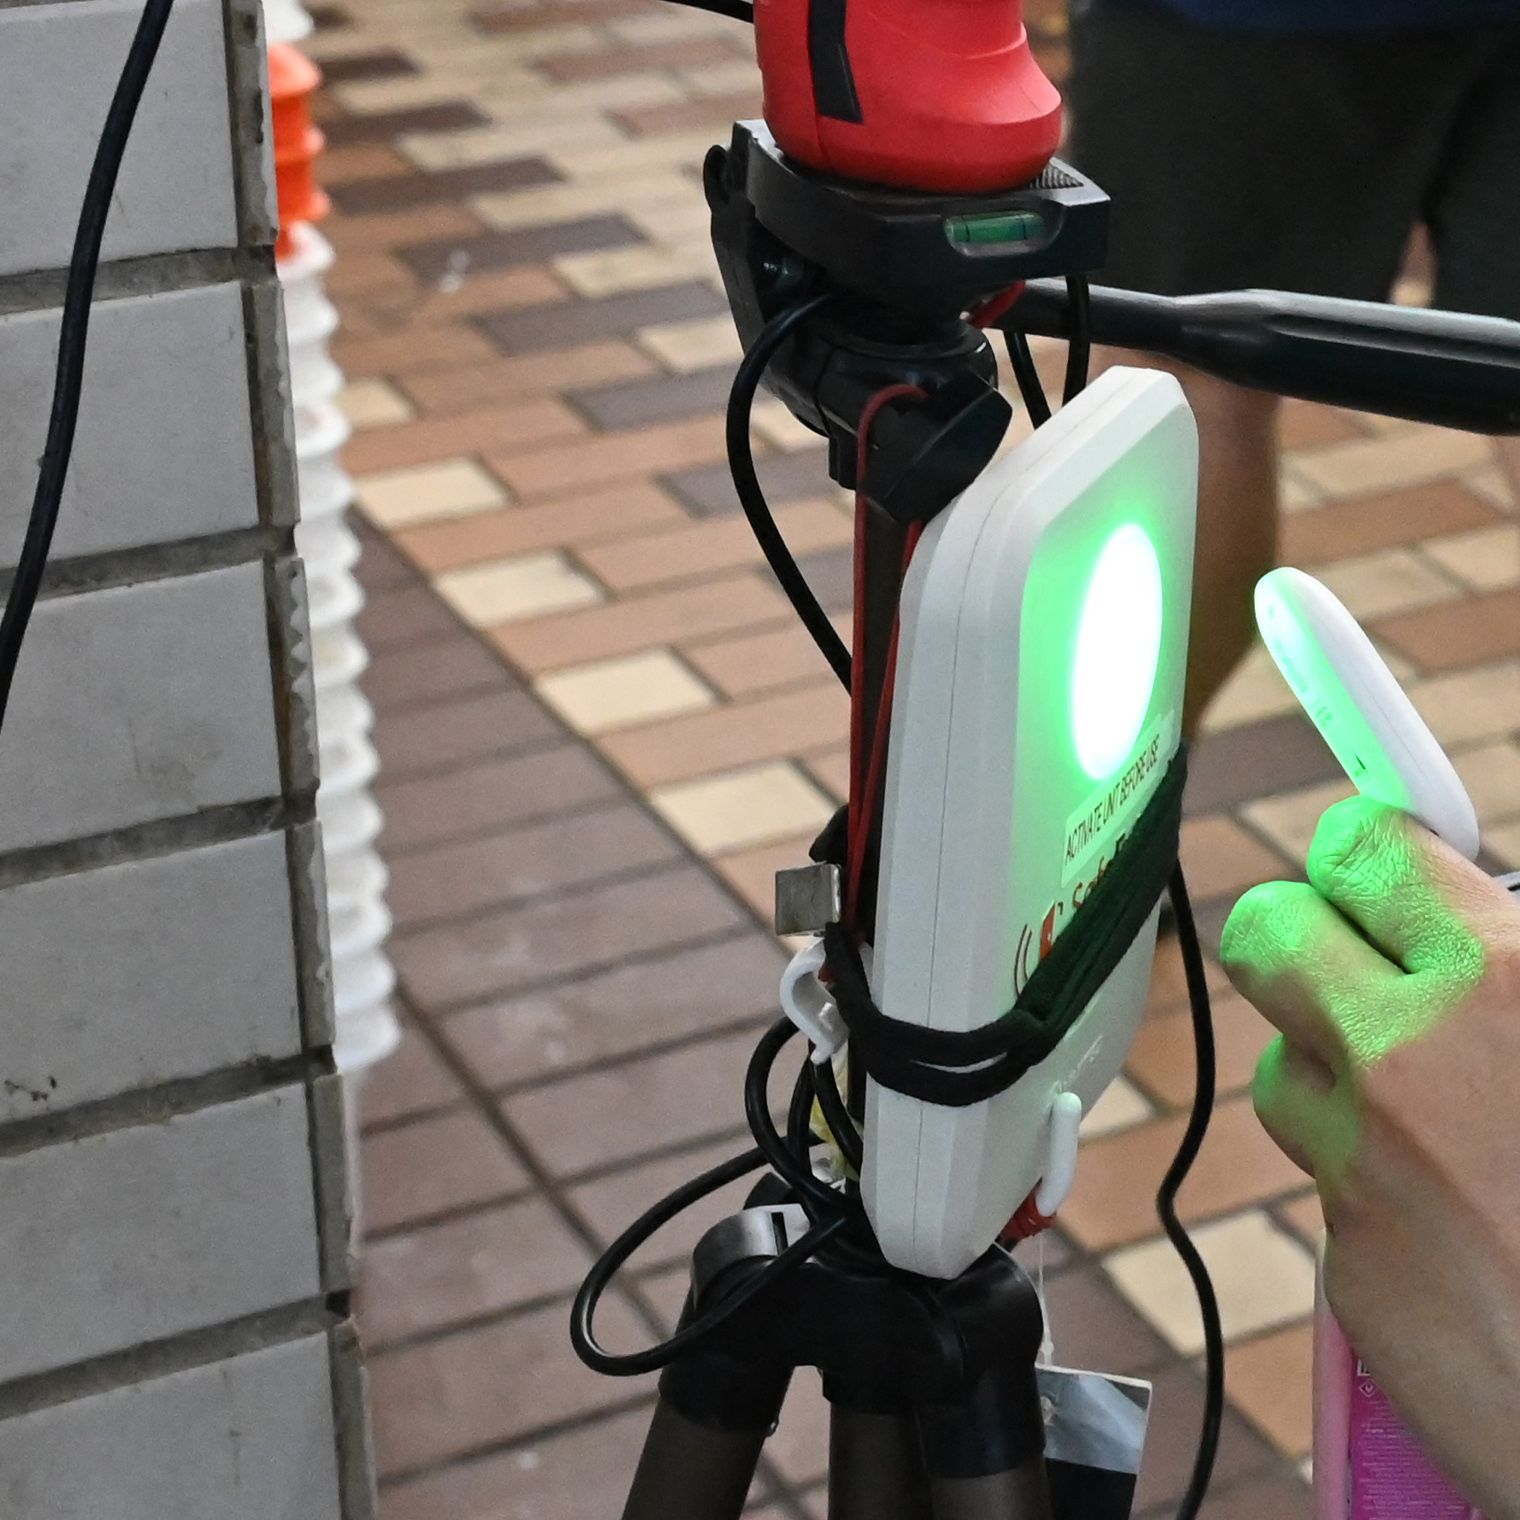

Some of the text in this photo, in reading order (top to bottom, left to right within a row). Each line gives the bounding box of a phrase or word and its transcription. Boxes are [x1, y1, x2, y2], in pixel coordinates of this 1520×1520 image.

[1064, 801, 1103, 866] ACTIVATE
[1103, 782, 1120, 825] UNIT
[1120, 750, 1147, 806] BEFORE
[1146, 733, 1160, 773] USE
